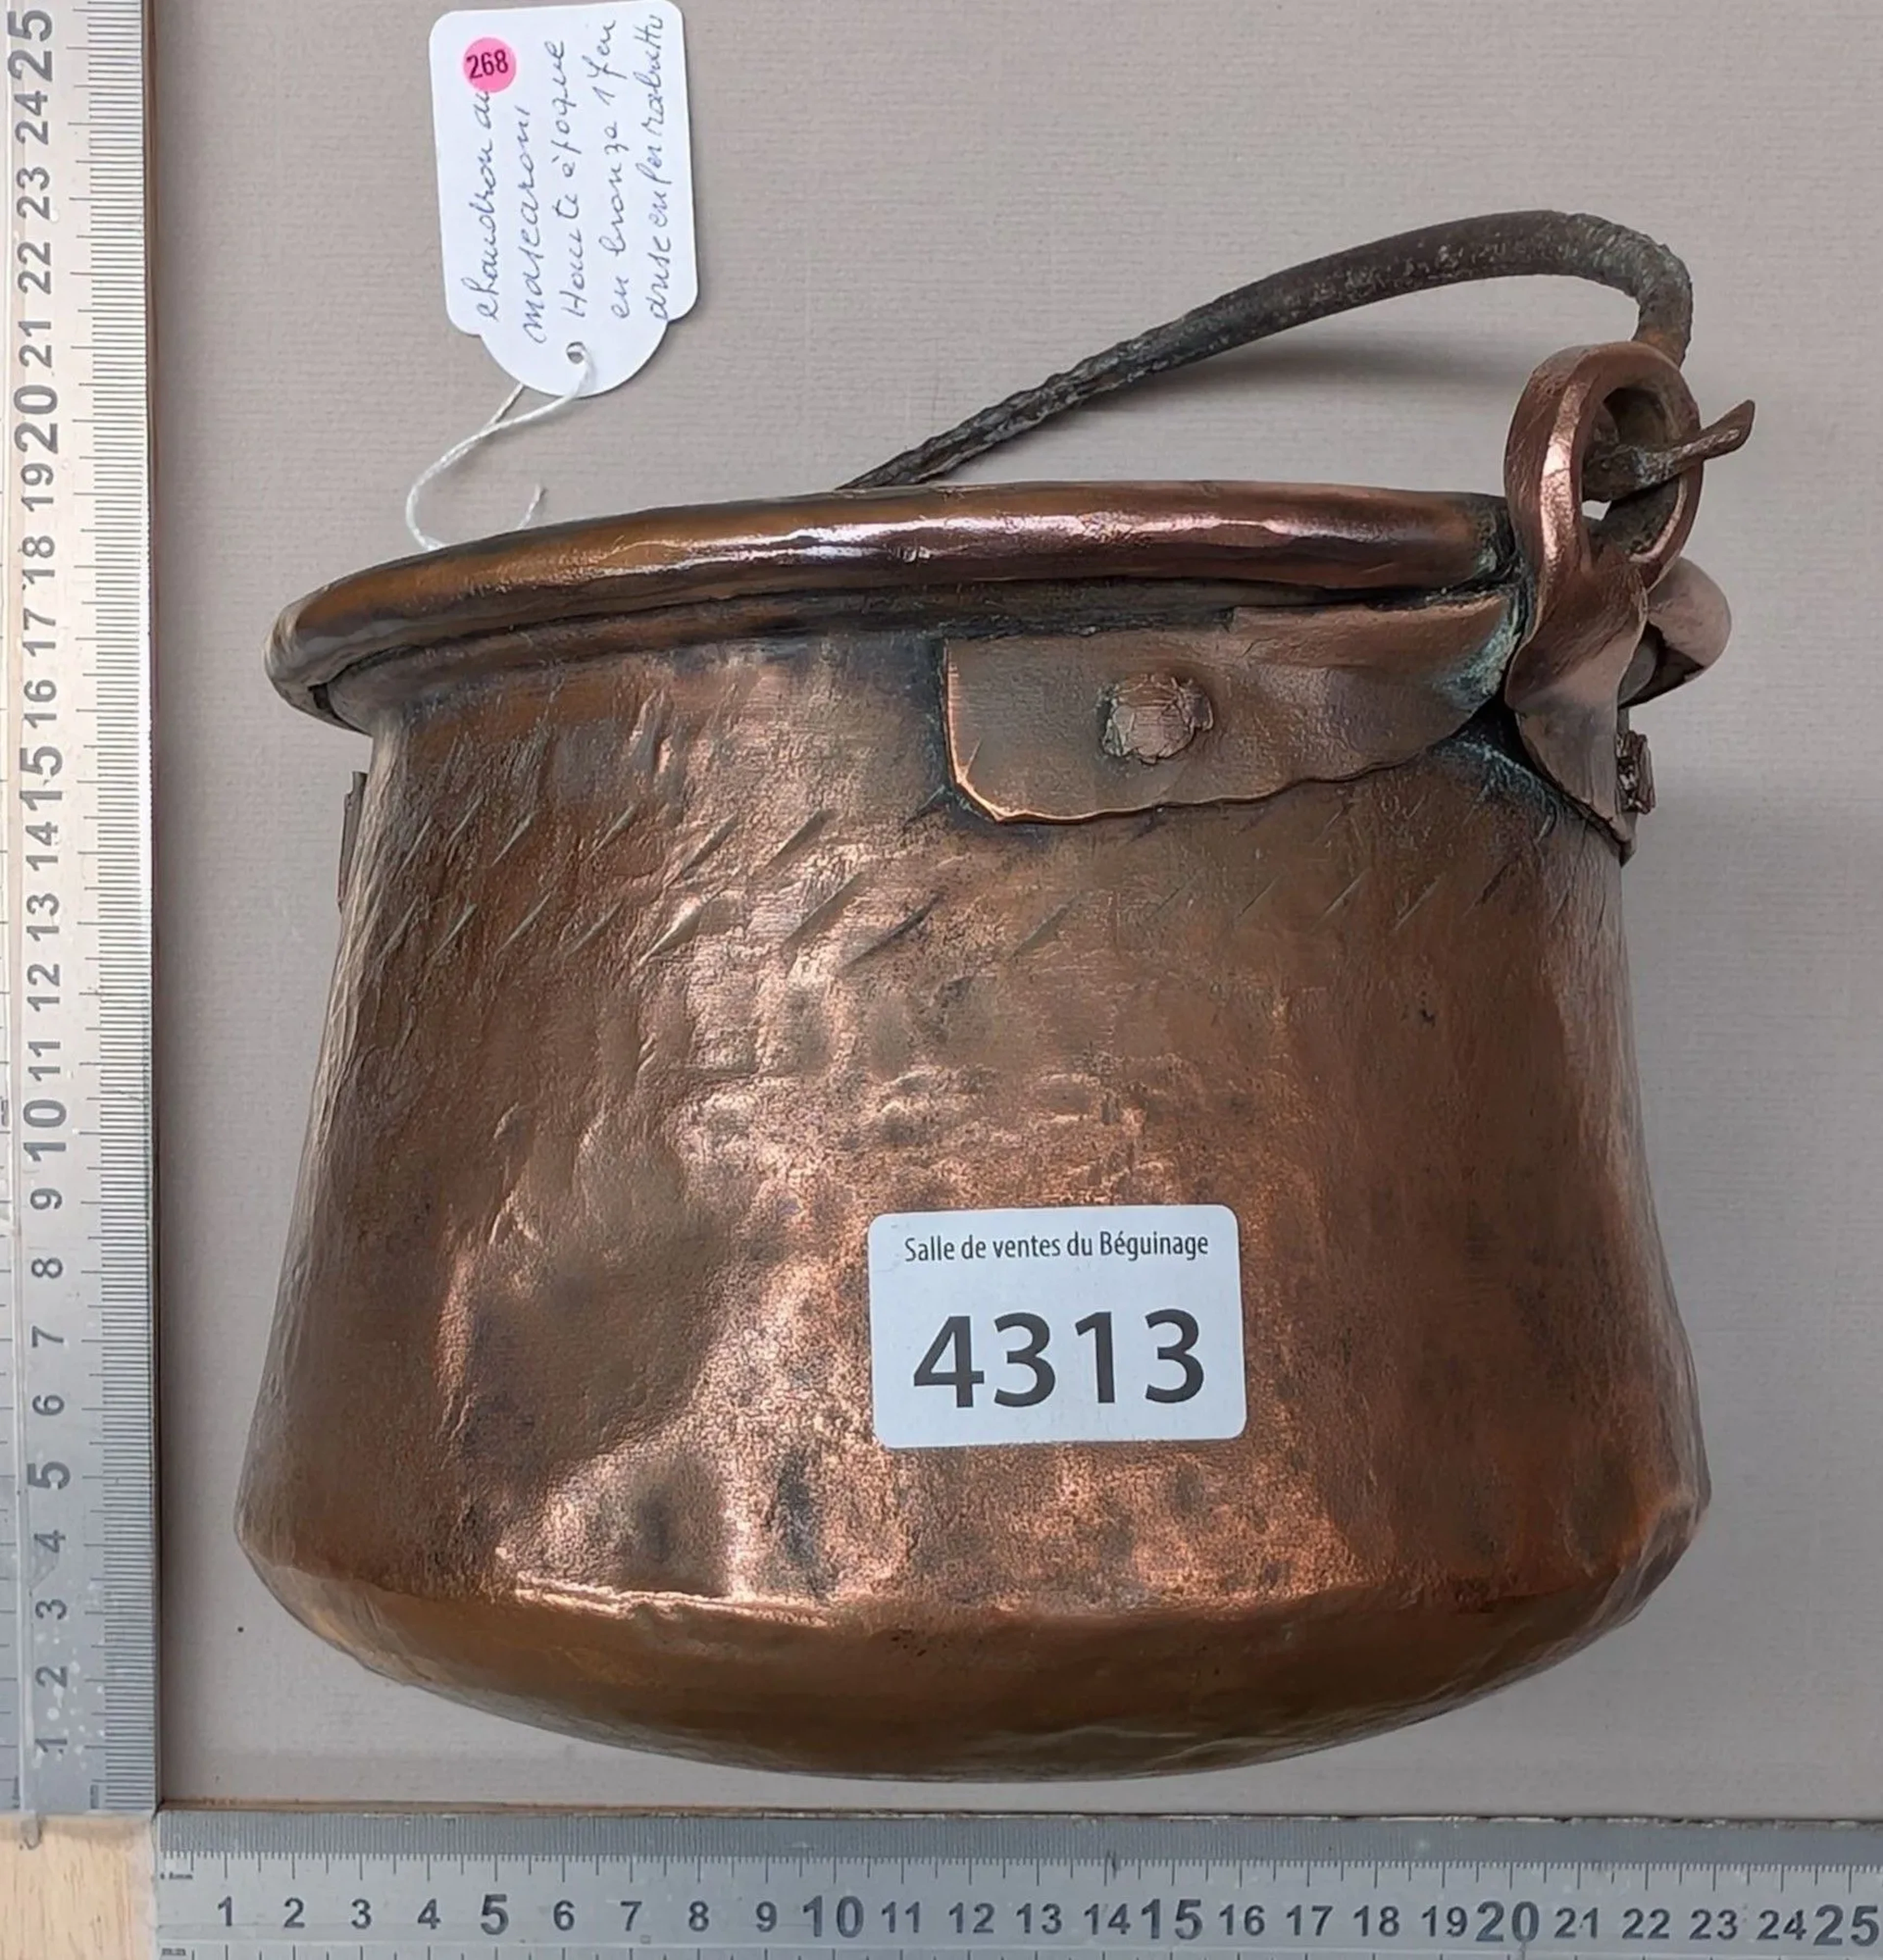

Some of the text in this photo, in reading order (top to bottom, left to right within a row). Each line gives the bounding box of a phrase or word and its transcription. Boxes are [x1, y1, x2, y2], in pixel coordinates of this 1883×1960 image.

[465, 48, 509, 80] 268
[7, 10, 71, 1753] 1 2 3 4 5 6 7 8 9 10 11 12 13 14 15 16 17 18 19 20 21 22 23 24 25
[905, 1230, 1208, 1262] Salle de ventes du Béguinage
[914, 1309, 1204, 1408] 4313
[217, 1894, 1879, 1946] 1 2 3 4 5 6 7 8 9 10 11 12 13 14 15 16 17 18 19 20 21 22 23 24 25
